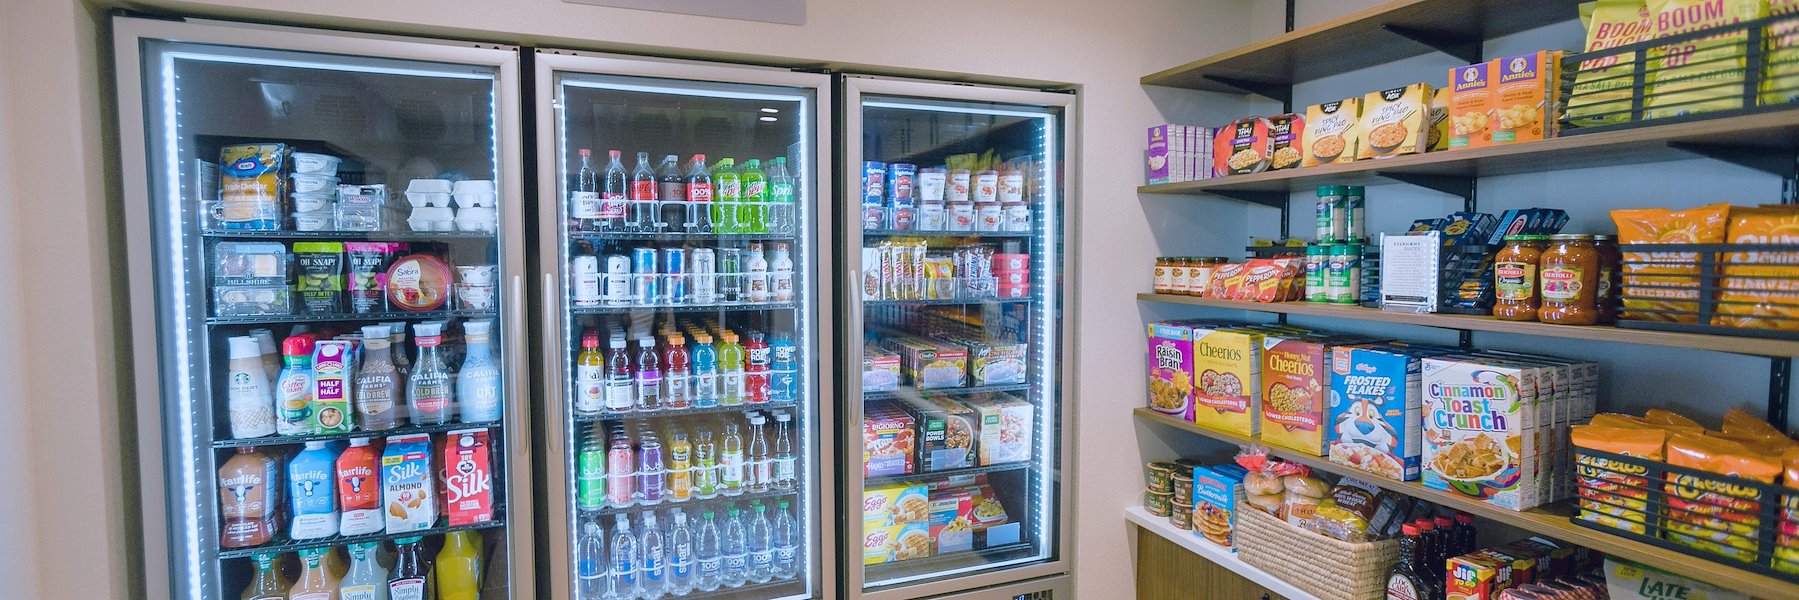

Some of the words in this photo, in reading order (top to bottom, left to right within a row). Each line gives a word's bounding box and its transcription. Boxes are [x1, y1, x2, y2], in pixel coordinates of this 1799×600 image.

[1657, 1, 1724, 32] BOOM
[1596, 20, 1653, 40] BOOM
[1501, 70, 1535, 82] Annie's
[1456, 79, 1486, 91] Annie's
[1372, 113, 1391, 124] KUNG
[1392, 106, 1408, 116] PAO
[1382, 102, 1402, 114] SPICY
[1322, 115, 1339, 125] SPICY
[241, 183, 267, 191] Cheddar
[397, 268, 419, 277] Sabra
[1157, 346, 1181, 361] Raisin
[1200, 342, 1242, 361] Cheerios
[1284, 352, 1300, 362] Honey
[1300, 354, 1311, 362] Nut
[1160, 358, 1179, 370] Bran
[1270, 354, 1314, 377] Cheerios
[356, 375, 392, 385] CALIFIA
[411, 372, 449, 381] CALIFIA
[1344, 376, 1392, 386] FROSTED
[356, 390, 372, 399] COLD
[372, 389, 391, 399] BREW
[412, 387, 430, 396] COLD
[1346, 385, 1386, 396] FLAKES
[1430, 381, 1506, 399] Cinnamon
[1444, 398, 1490, 414] Toast
[1266, 411, 1281, 420] LOWER
[1282, 414, 1314, 426] CHOLESTEROL
[1435, 410, 1507, 430] Crunch
[292, 470, 328, 481] fairlife
[338, 466, 372, 478] fairlife
[389, 462, 422, 483] Silk
[221, 475, 262, 487] fairlife
[390, 482, 422, 492] ALMOND
[448, 469, 490, 503] Silk
[1197, 484, 1228, 503] Buttermilk
[864, 496, 888, 512] Eggo
[865, 532, 889, 548] Eggo
[652, 545, 661, 576] smart
[678, 543, 687, 573] smart
[1452, 566, 1476, 581] Jif
[1497, 566, 1512, 583] Jif
[1396, 578, 1408, 588] LOG
[1638, 576, 1690, 598] LATE
